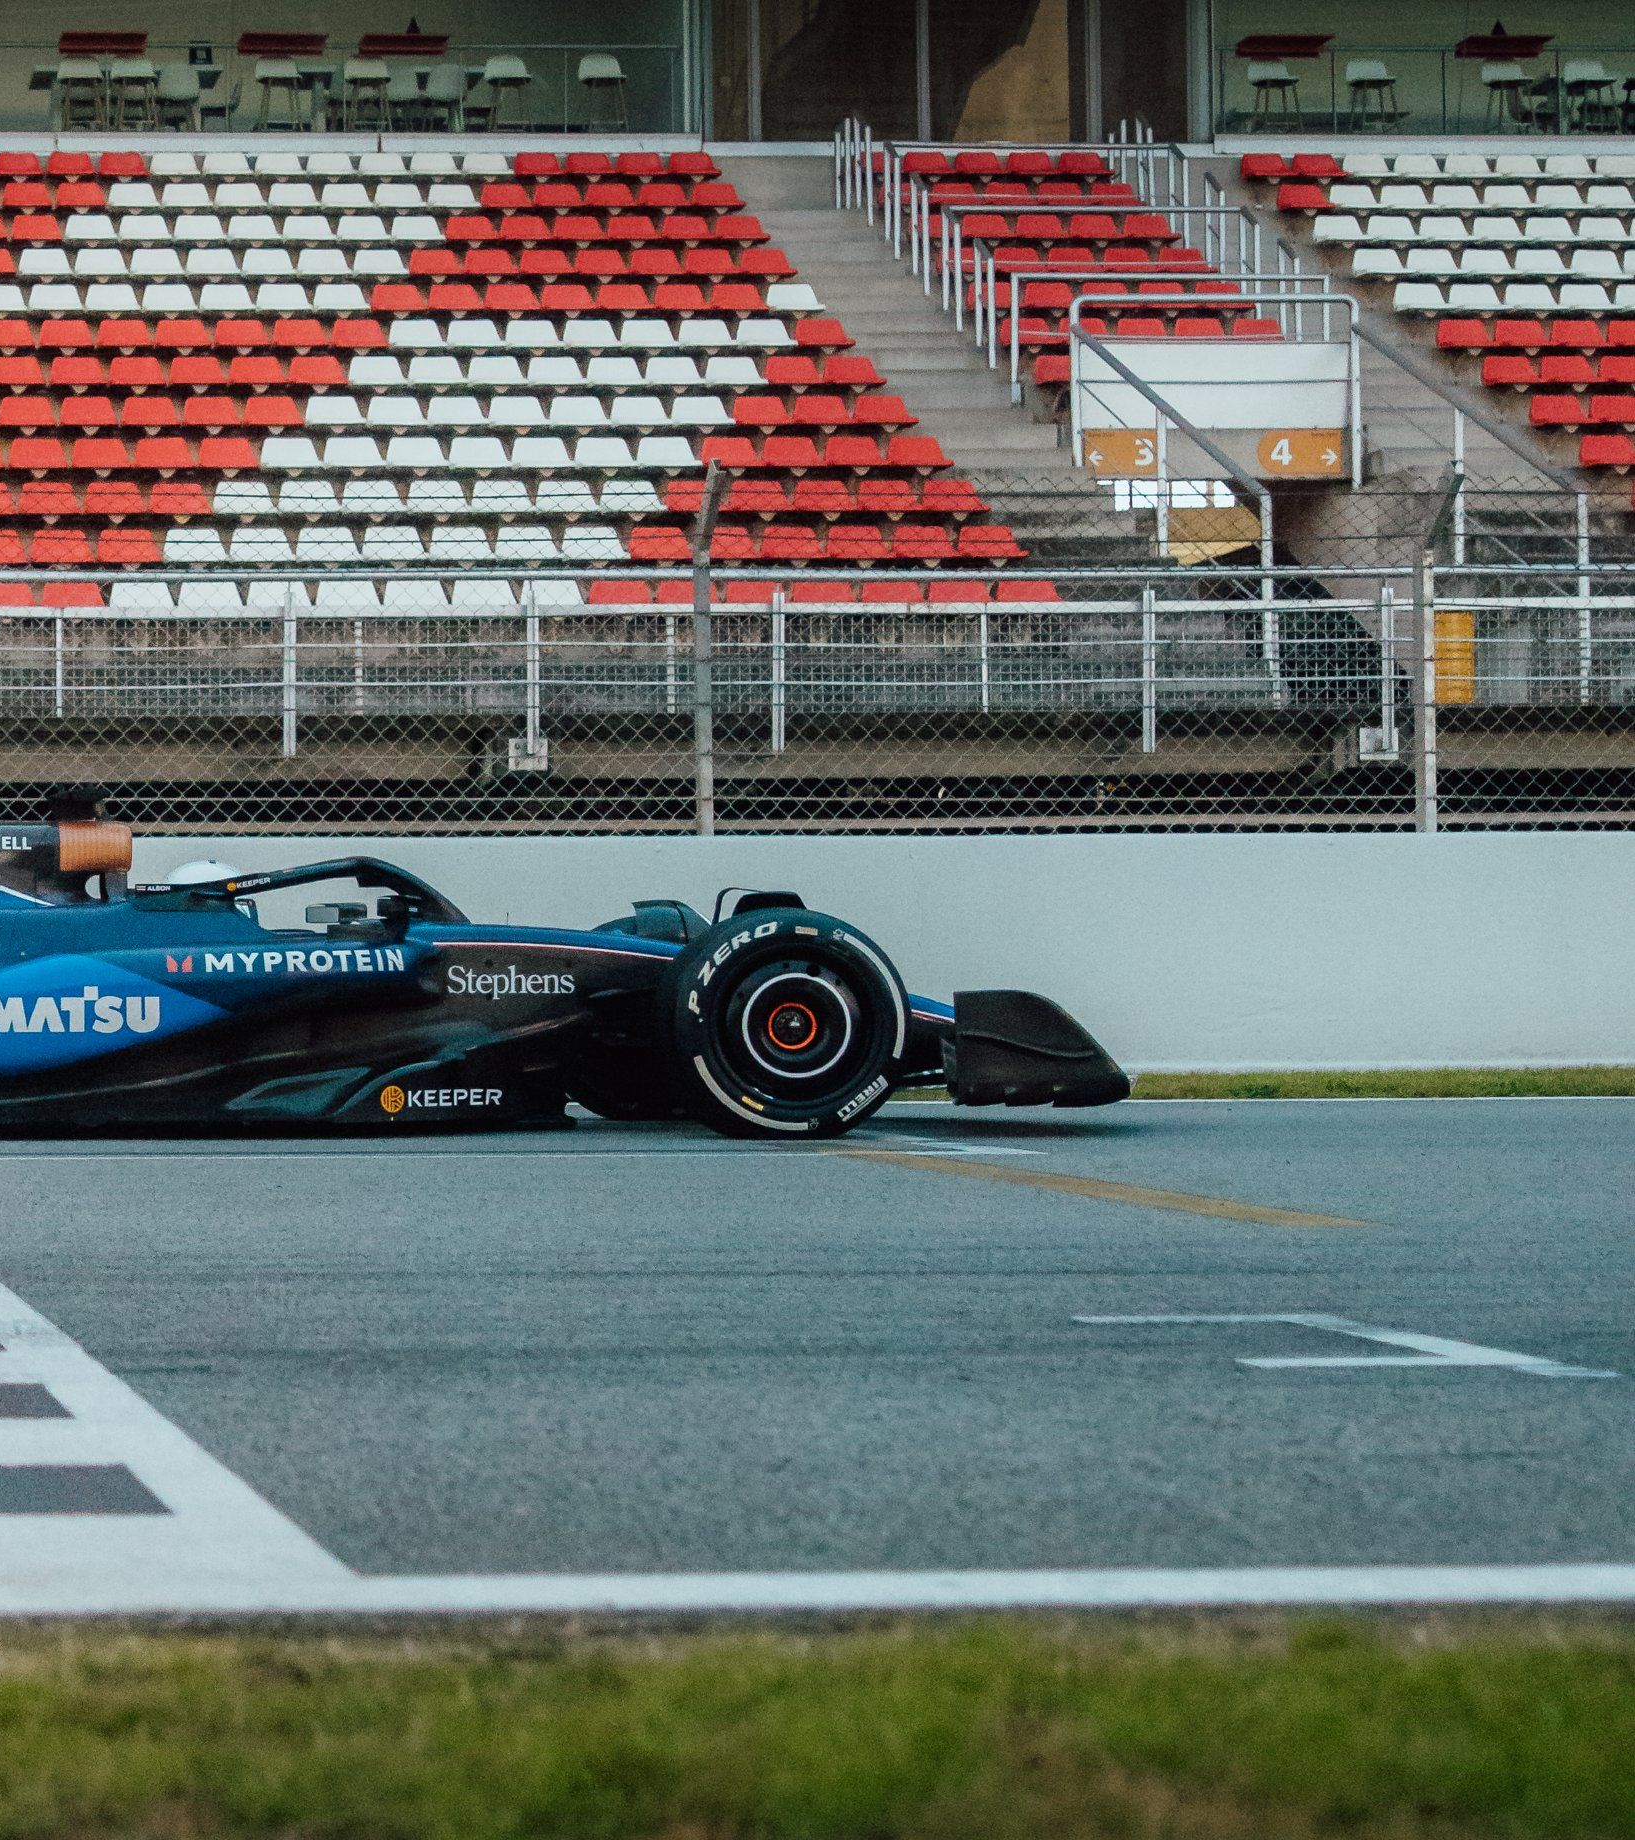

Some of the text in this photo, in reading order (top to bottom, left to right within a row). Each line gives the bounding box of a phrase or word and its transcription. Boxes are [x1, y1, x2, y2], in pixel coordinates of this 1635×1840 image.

[1134, 438, 1154, 466] 3
[1270, 438, 1293, 466] 4
[236, 877, 271, 889] KEEPER
[204, 949, 405, 973] MYPROTEIN
[688, 921, 779, 1015] P ZERO
[447, 965, 576, 1000] Stephens
[407, 1088, 503, 1107] KEEPER
[837, 1074, 889, 1122] PIRELLI
